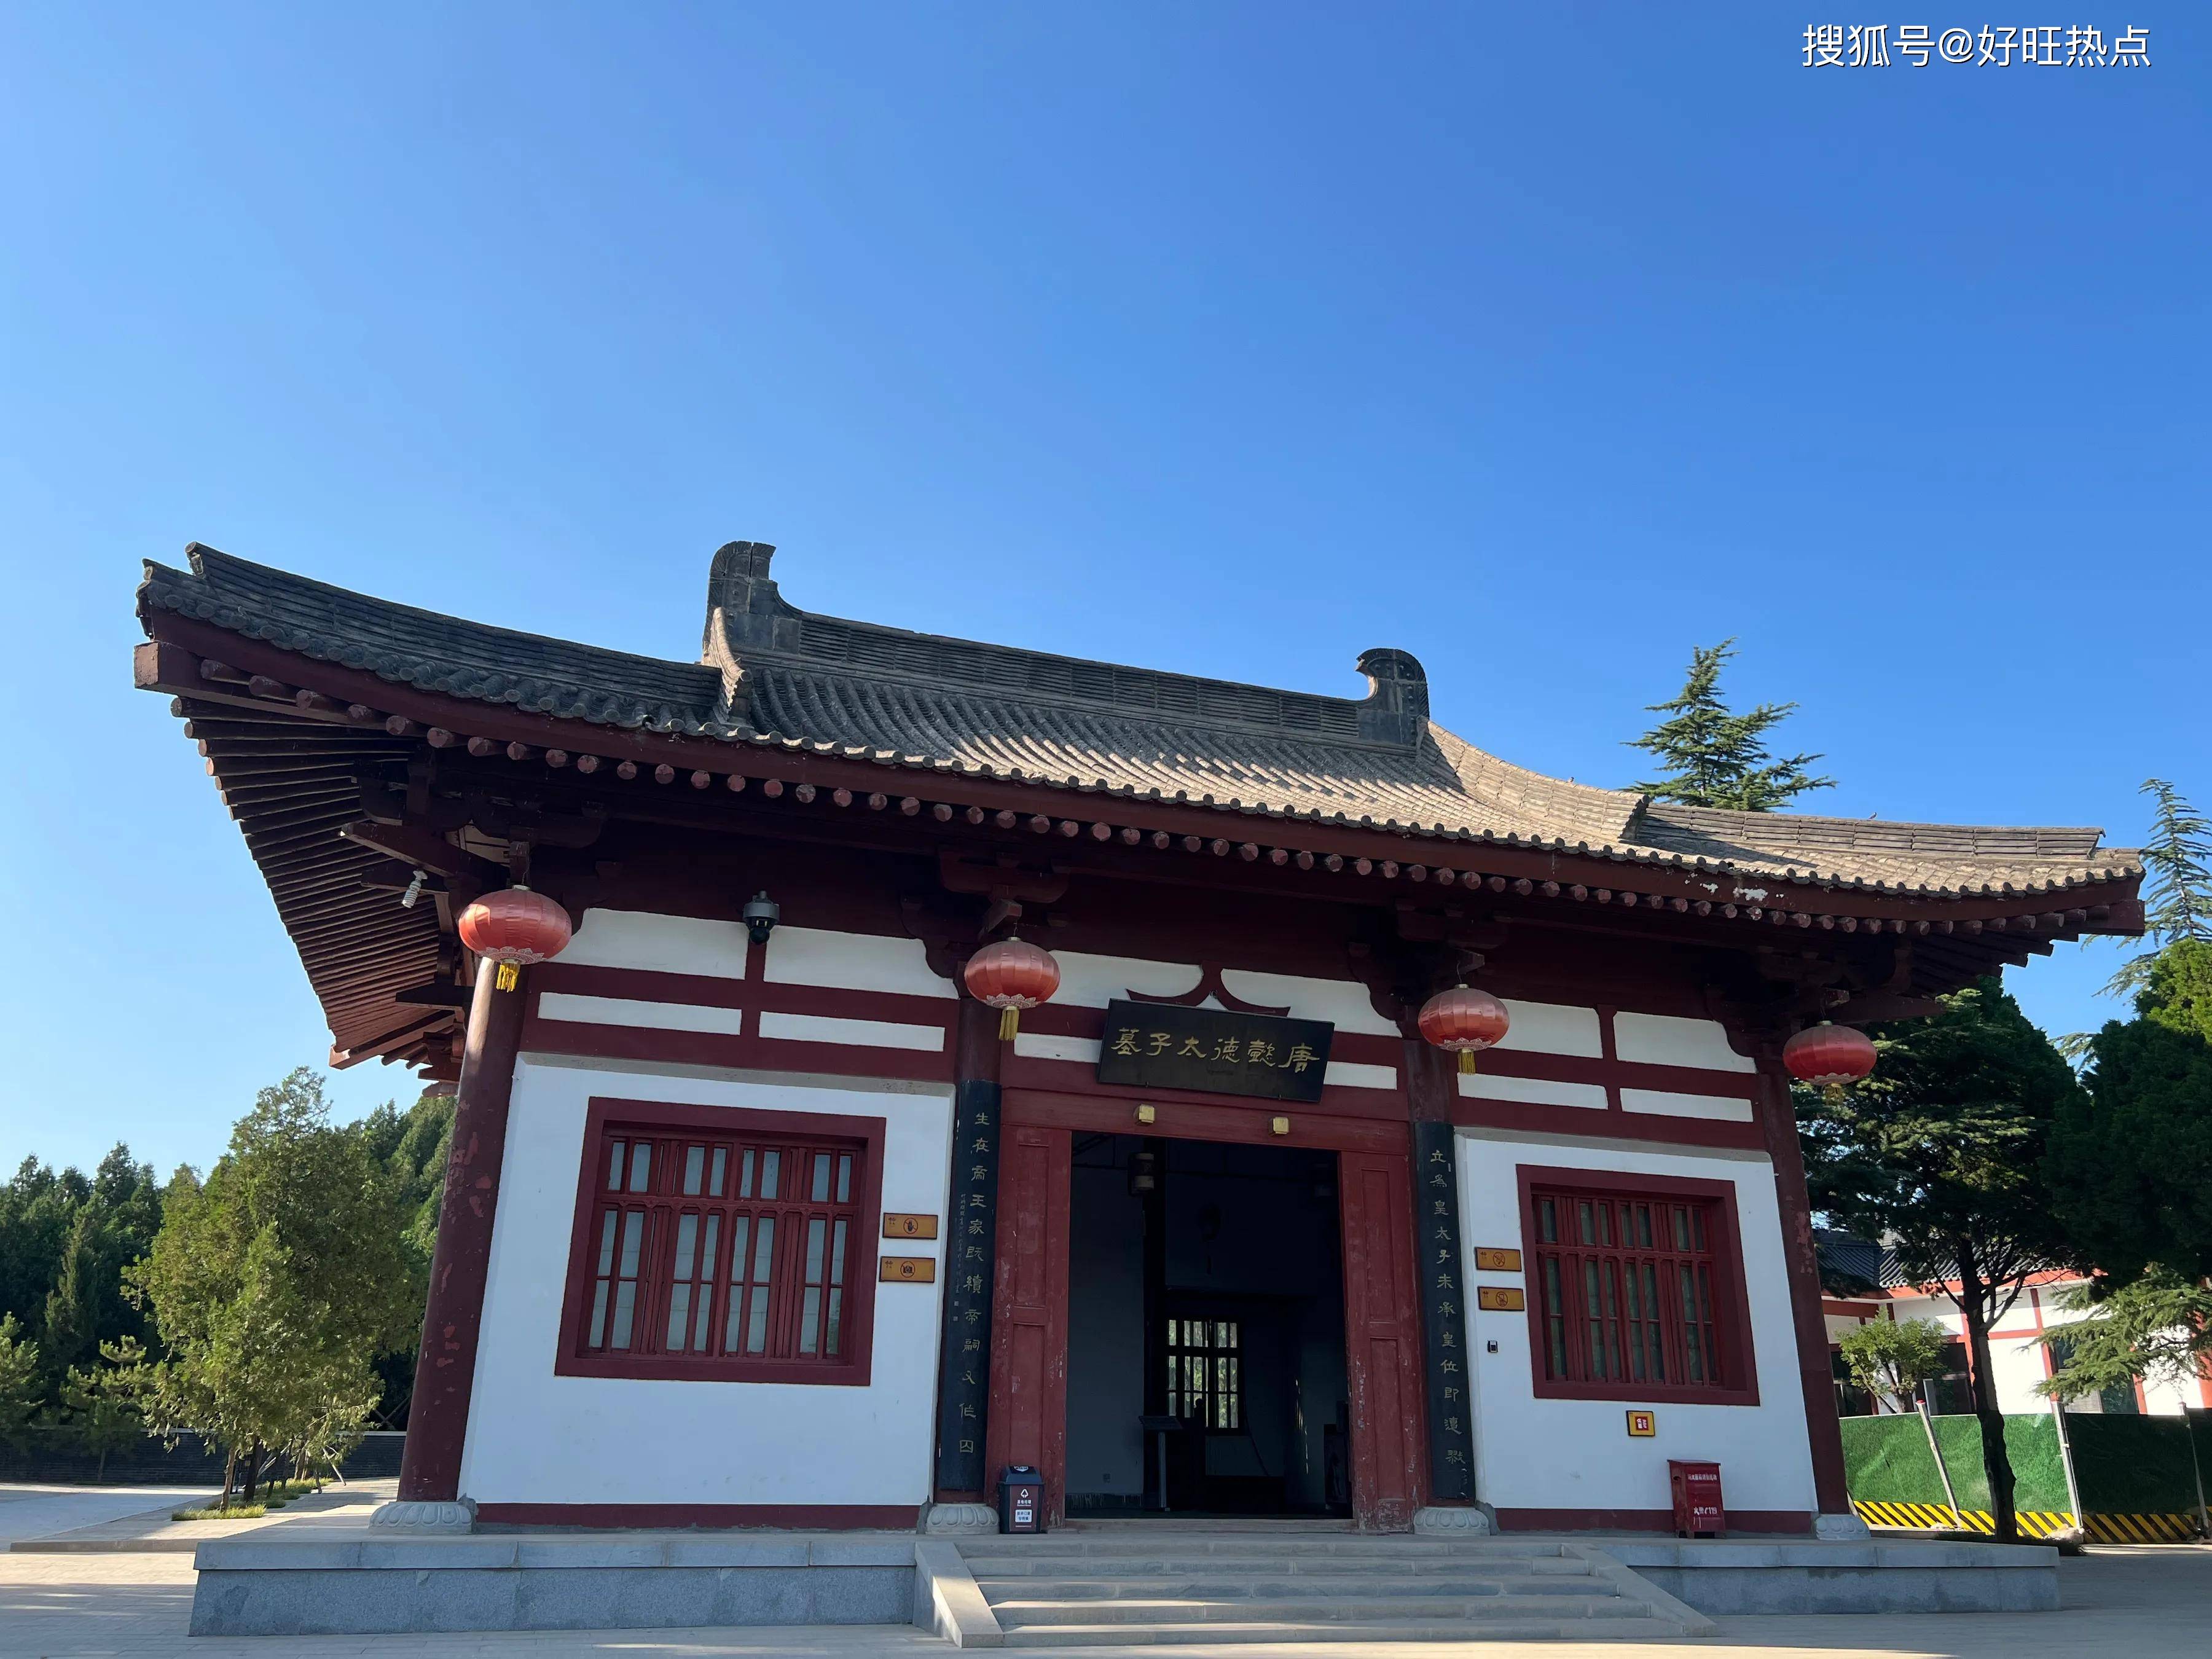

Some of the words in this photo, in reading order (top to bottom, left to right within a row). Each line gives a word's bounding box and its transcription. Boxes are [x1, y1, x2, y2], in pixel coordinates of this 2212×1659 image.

[1110, 1027, 1320, 1073] 唐懿德太子墓
